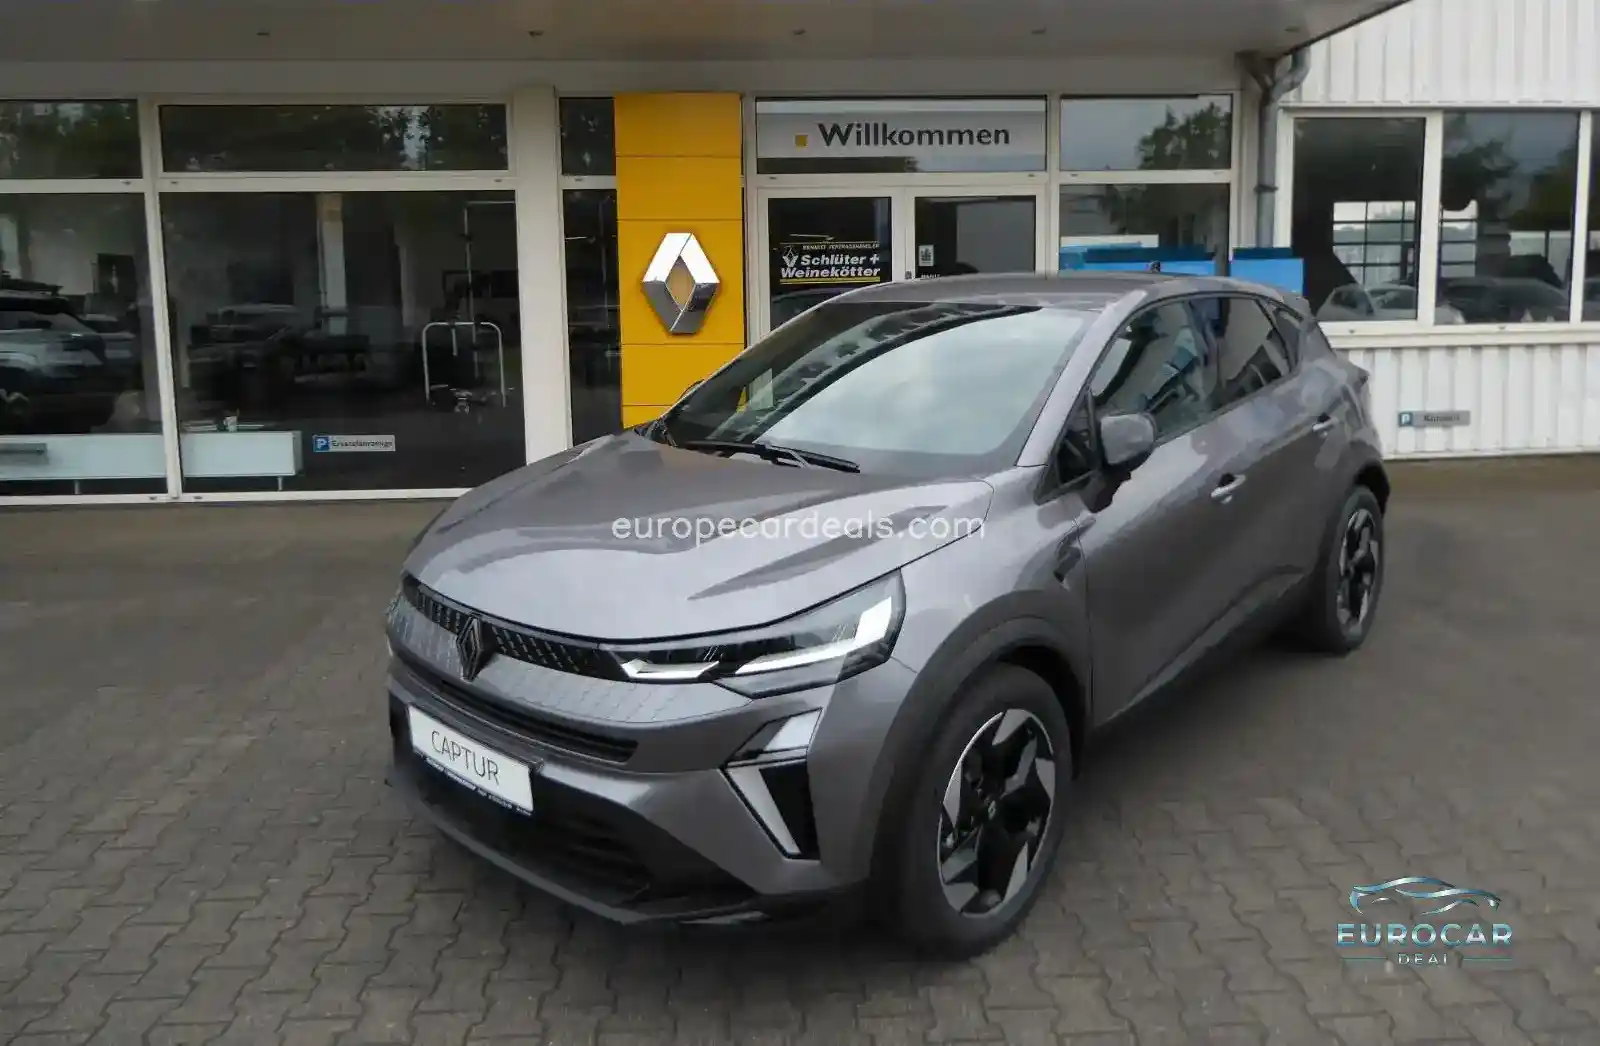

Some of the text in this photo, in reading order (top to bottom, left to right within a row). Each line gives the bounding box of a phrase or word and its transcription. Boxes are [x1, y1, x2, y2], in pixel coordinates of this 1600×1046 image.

[817, 122, 1010, 147] Willkommen
[801, 253, 880, 266] Schlüter +
[781, 266, 880, 279] Weinekötter
[431, 730, 500, 786] CAPTUR
